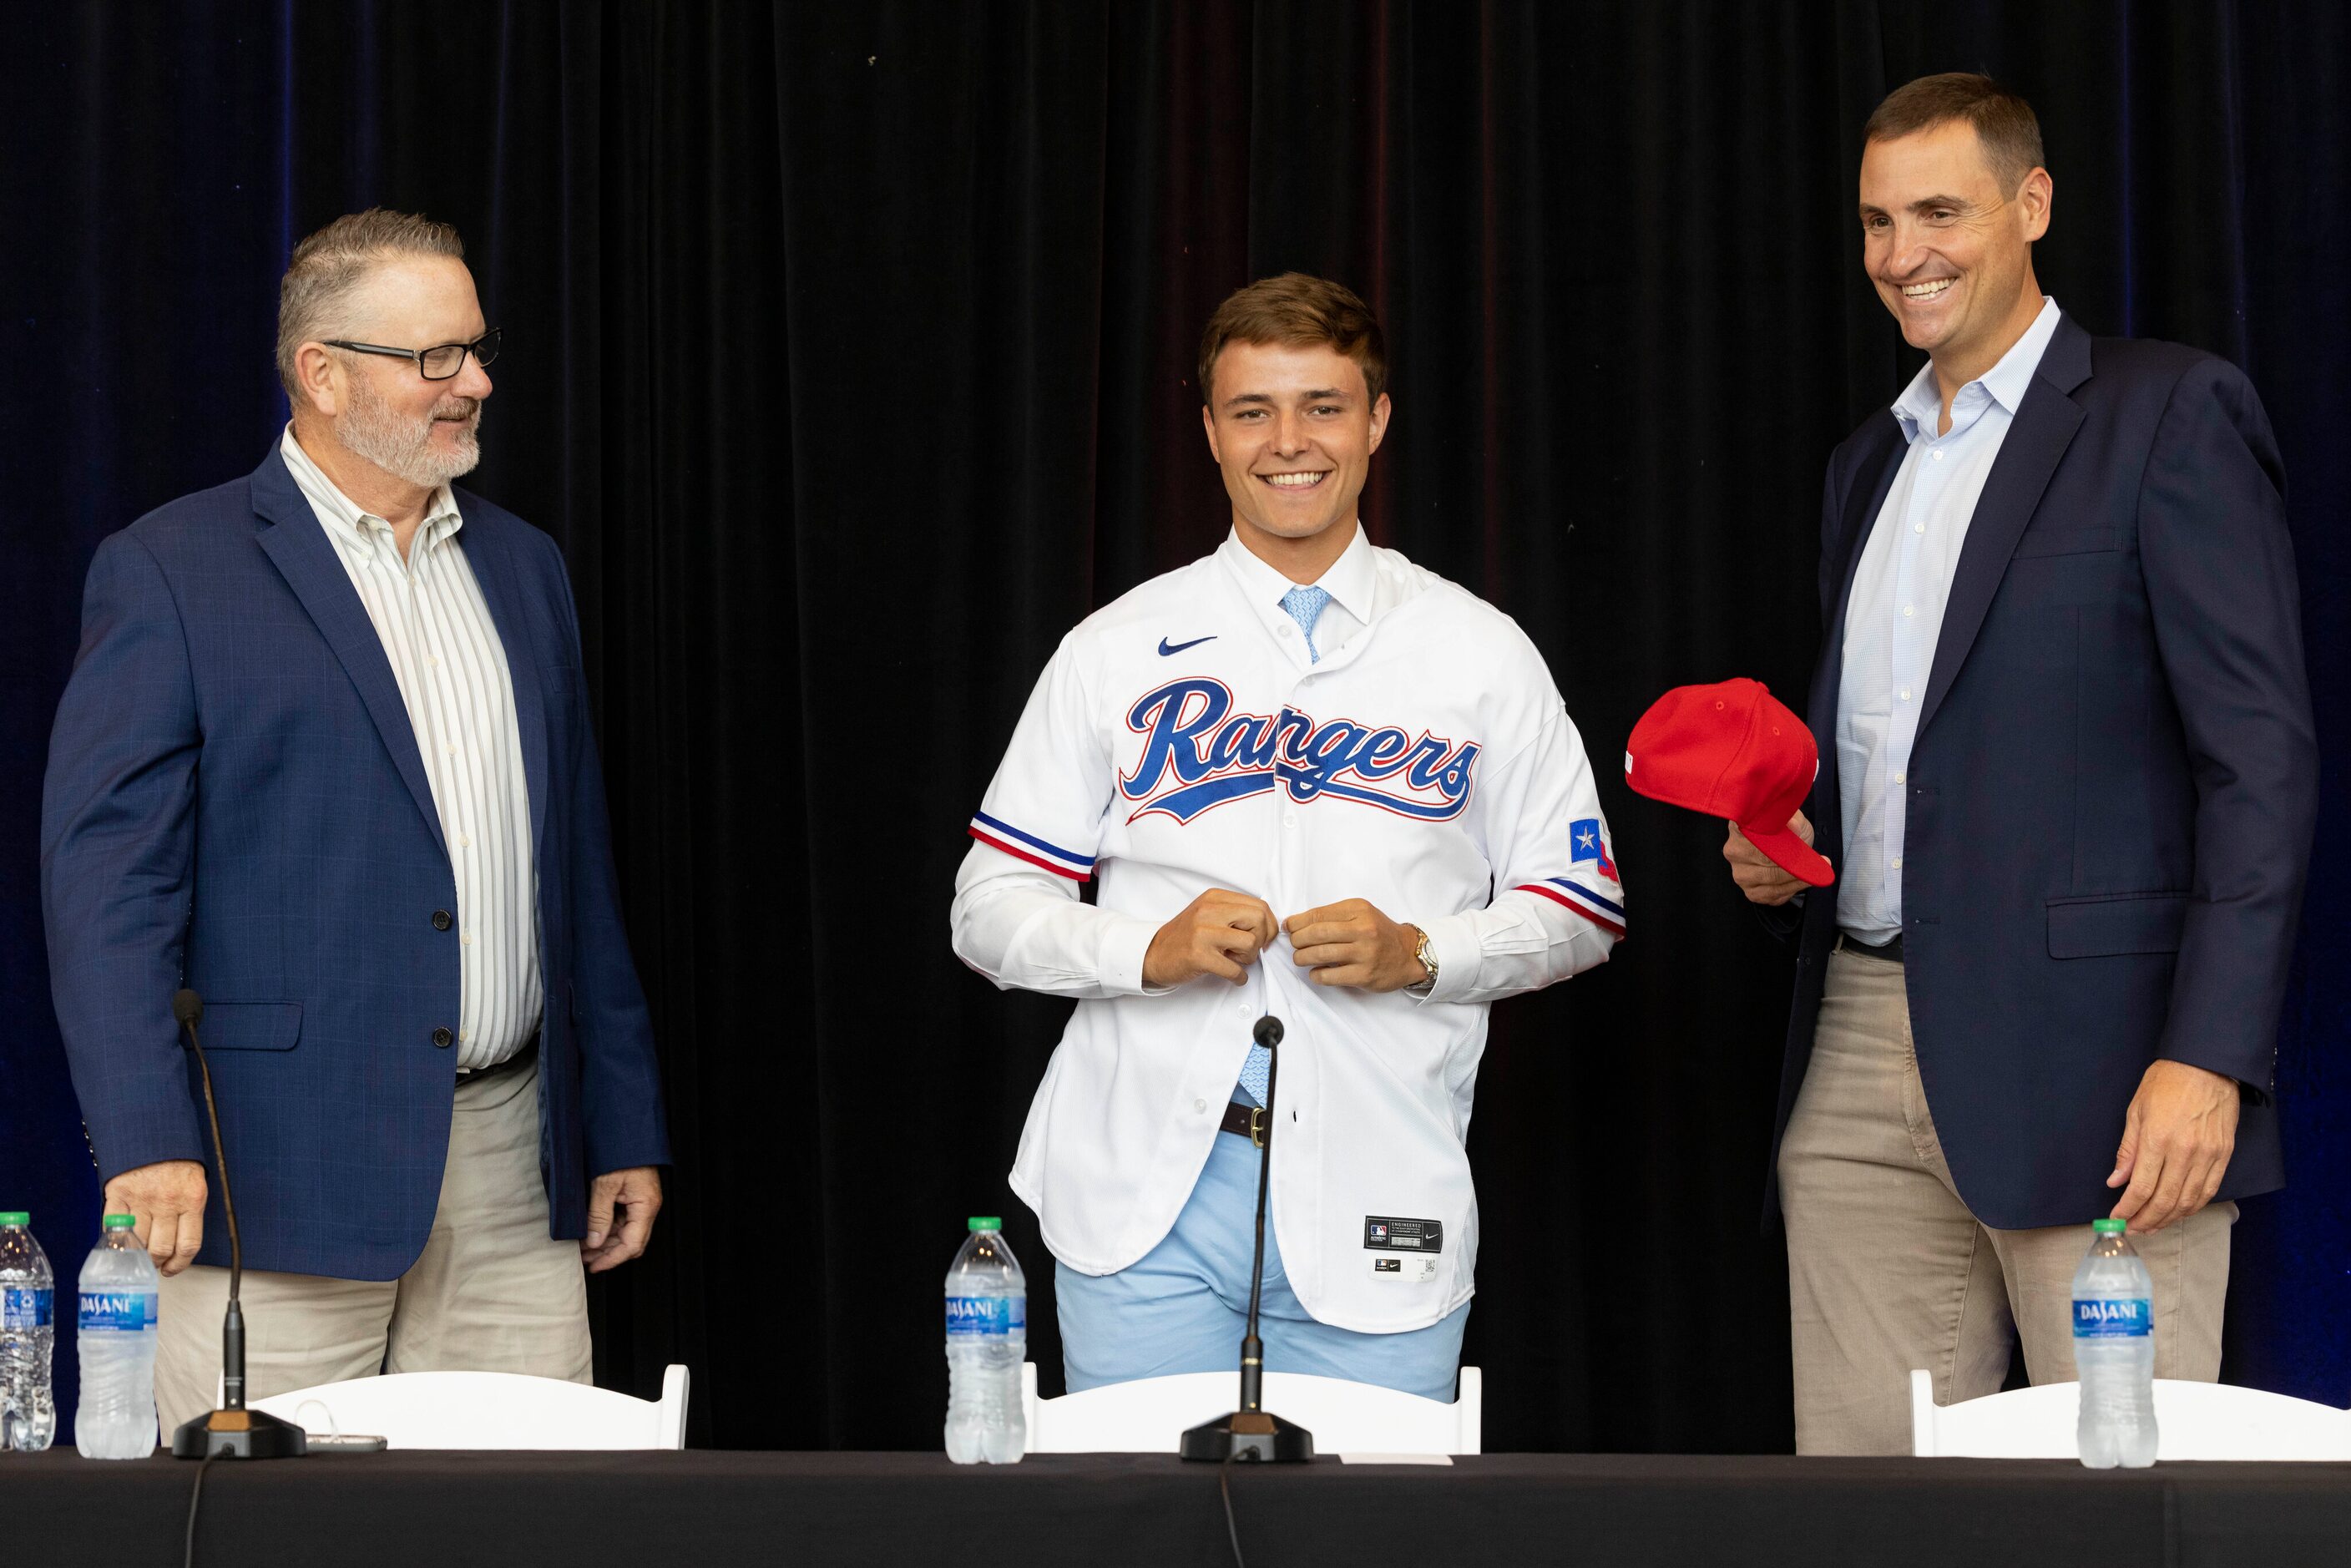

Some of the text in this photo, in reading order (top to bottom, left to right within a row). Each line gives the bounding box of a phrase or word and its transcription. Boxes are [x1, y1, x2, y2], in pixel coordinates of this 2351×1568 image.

[1120, 676, 1483, 807] Rangers
[80, 1294, 130, 1317] DASANI
[2081, 1301, 2137, 1323] DASANI
